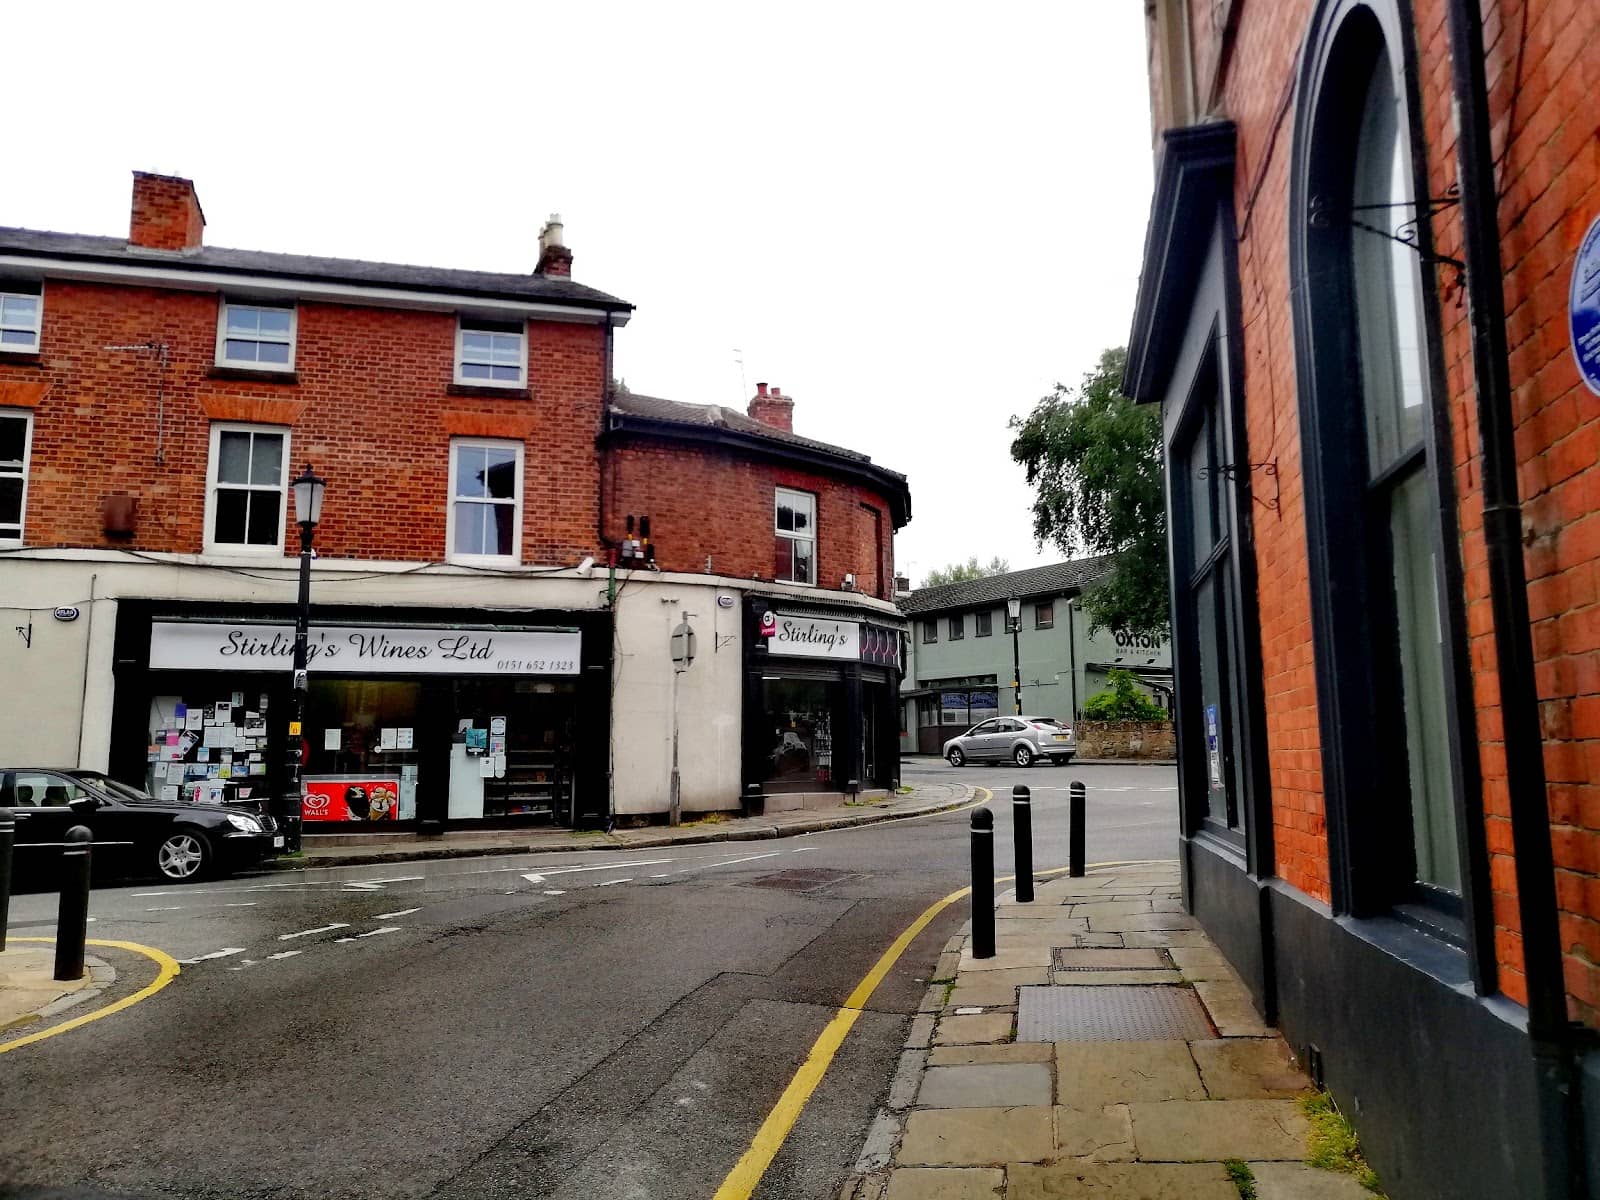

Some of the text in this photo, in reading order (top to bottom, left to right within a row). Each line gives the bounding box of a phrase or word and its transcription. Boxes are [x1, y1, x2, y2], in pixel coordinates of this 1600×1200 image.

[779, 620, 848, 652] Stirling's
[1115, 632, 1161, 649] OXTON
[348, 633, 433, 660] Wines
[437, 635, 494, 661] Ltd
[497, 660, 522, 670] 0151
[526, 660, 545, 670] 652
[304, 808, 329, 816] WALL'S
